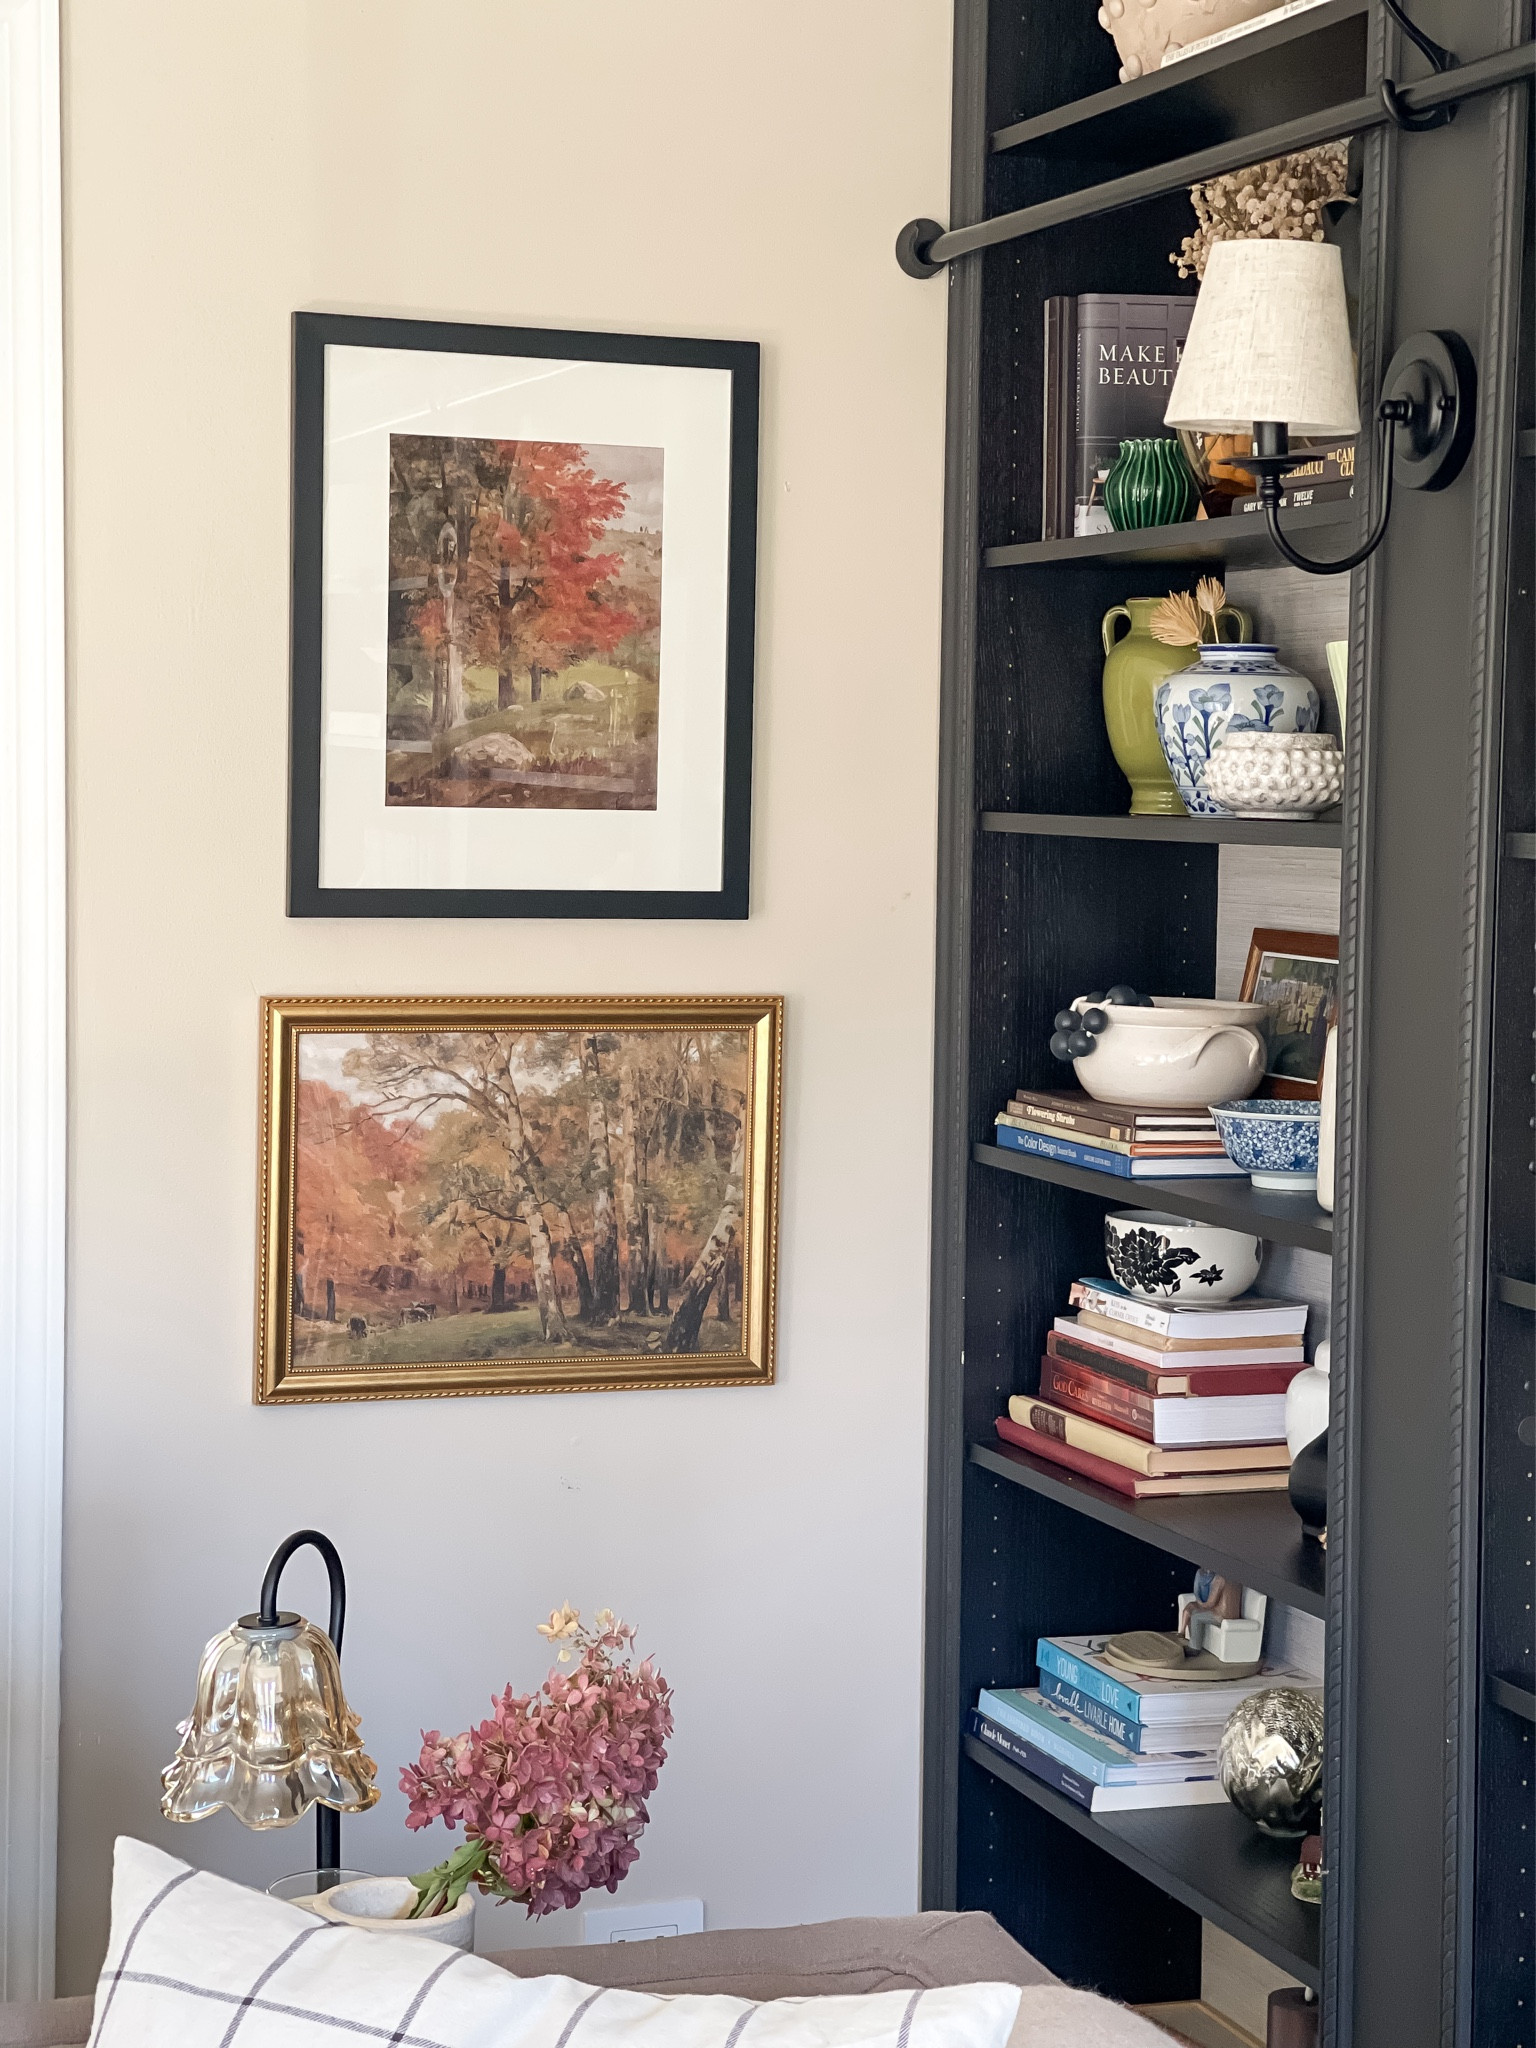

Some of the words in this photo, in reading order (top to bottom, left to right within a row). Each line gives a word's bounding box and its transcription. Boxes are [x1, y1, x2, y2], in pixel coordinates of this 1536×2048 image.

[1099, 344, 1165, 363] MAKE
[1098, 367, 1173, 386] BEAUT
[1336, 446, 1355, 463] CAM
[1340, 461, 1355, 477] CLU
[1294, 489, 1314, 502] TWELVE
[1026, 1105, 1056, 1122] Flowering
[1056, 1112, 1076, 1126] Shrubs
[1024, 1135, 1038, 1150] Color
[1038, 1138, 1057, 1157] Design
[1056, 1655, 1079, 1684] YOUNG
[1101, 1681, 1119, 1710] LOVE
[1084, 1701, 1108, 1730] LIVABLE
[1108, 1715, 1127, 1741] HOME
[980, 1721, 997, 1741] Claude
[996, 1731, 1011, 1750] Monet
